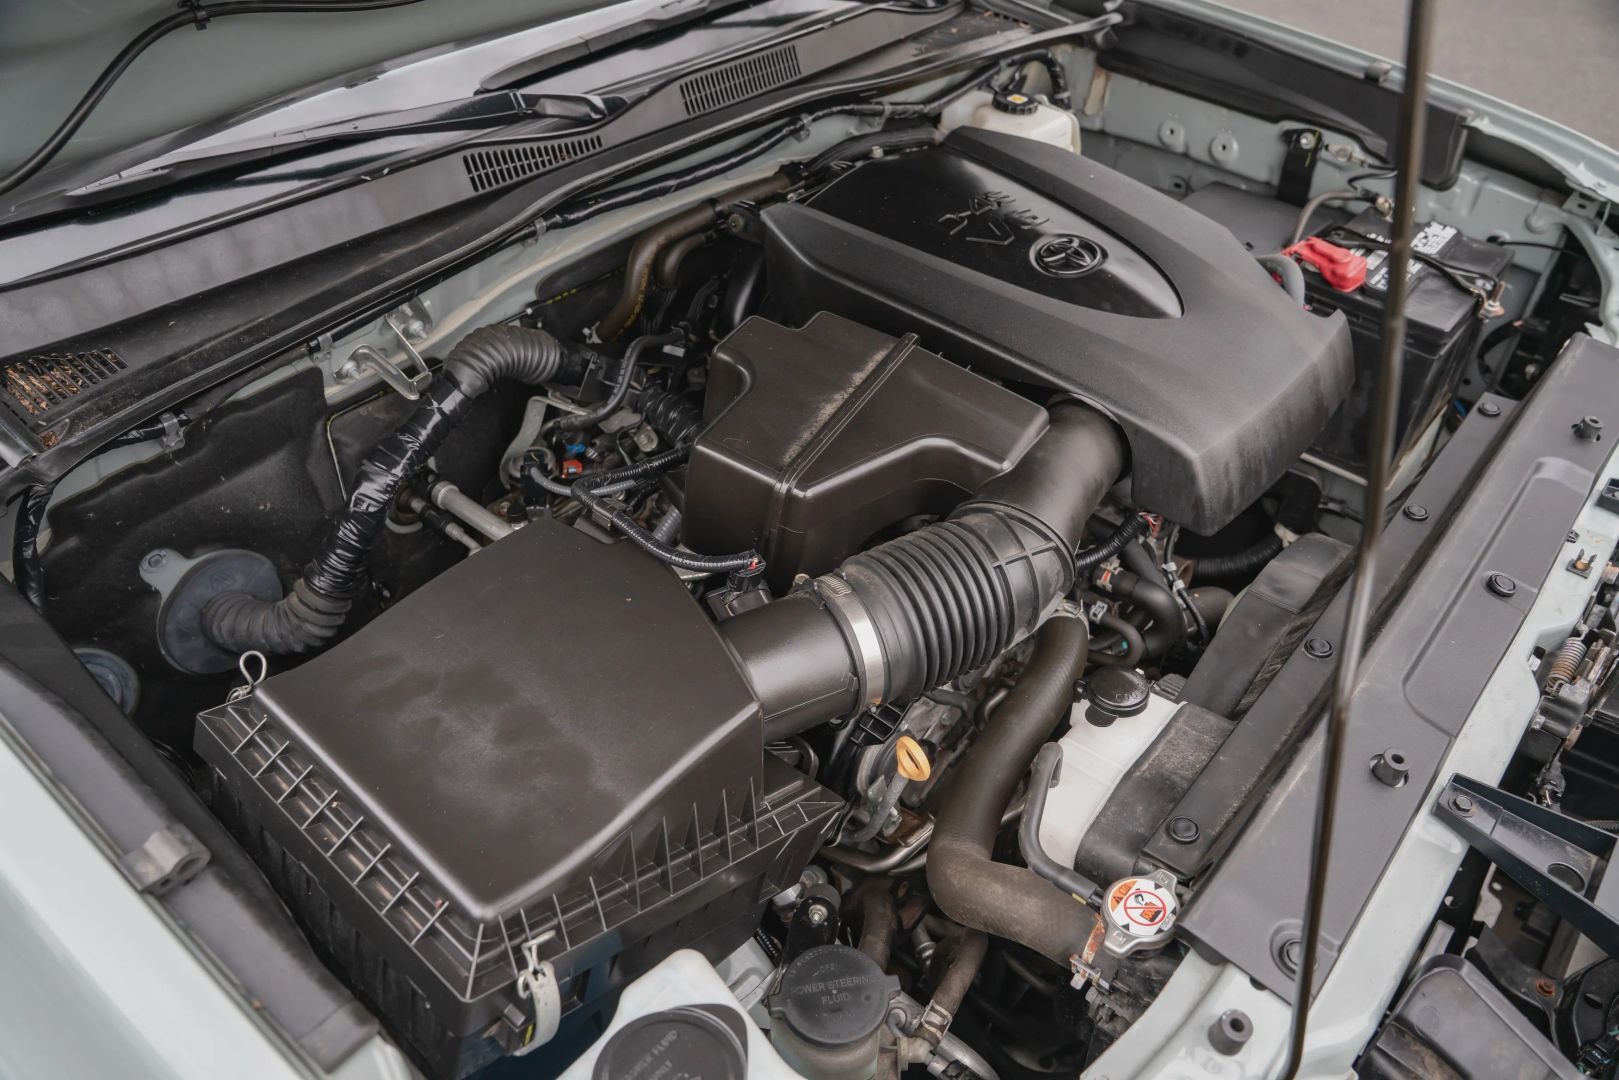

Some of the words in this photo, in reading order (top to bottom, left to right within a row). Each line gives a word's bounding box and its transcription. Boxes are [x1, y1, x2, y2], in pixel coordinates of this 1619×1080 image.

[827, 975, 877, 991] STEERING
[822, 993, 852, 1006] FLUID
[652, 1030, 678, 1056] FLUID
